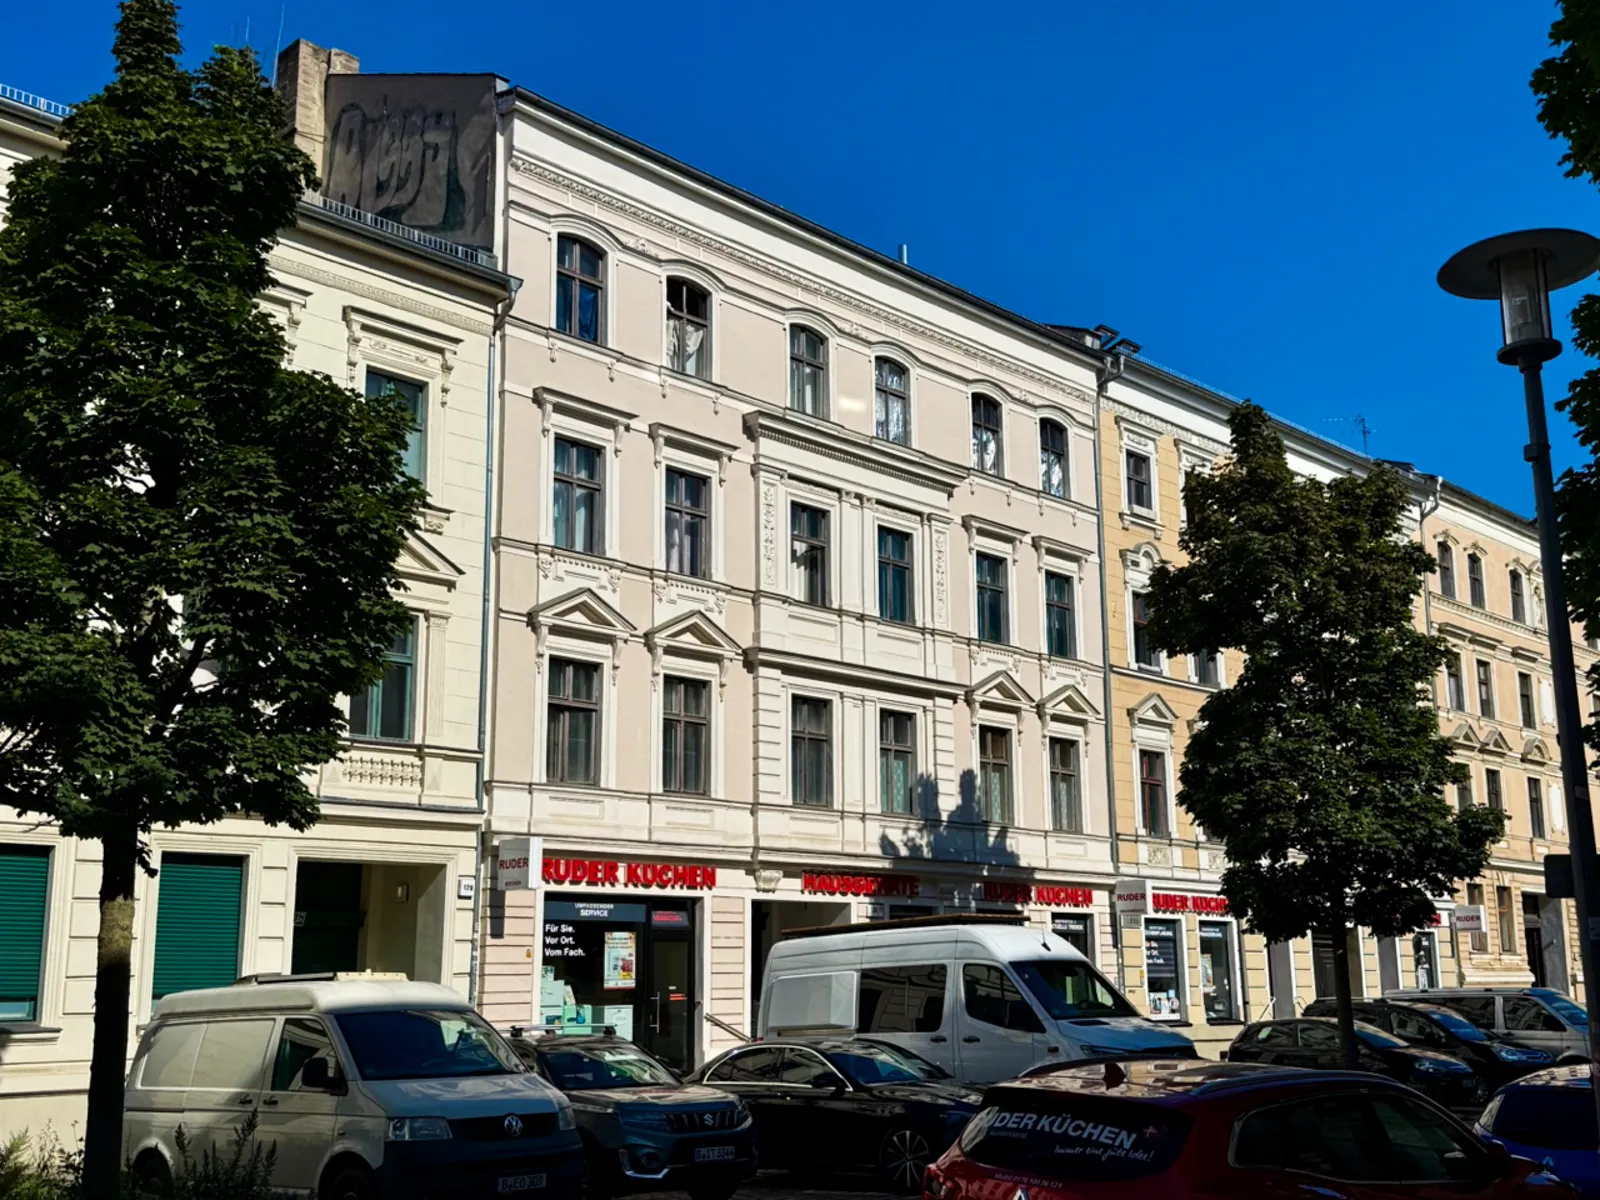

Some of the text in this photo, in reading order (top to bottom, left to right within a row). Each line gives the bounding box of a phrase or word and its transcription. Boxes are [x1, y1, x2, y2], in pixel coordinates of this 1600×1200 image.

[499, 857, 529, 870] RUDER
[541, 857, 620, 883] RUDER
[1117, 892, 1146, 902] RUDER
[580, 909, 609, 917] SERVICE
[1456, 914, 1481, 922] RUDER
[545, 924, 575, 933] Für Sie.
[545, 936, 575, 945] Vor Ort.
[544, 948, 586, 957] Vom Fach.
[1037, 1113, 1138, 1150] KÜCHEN
